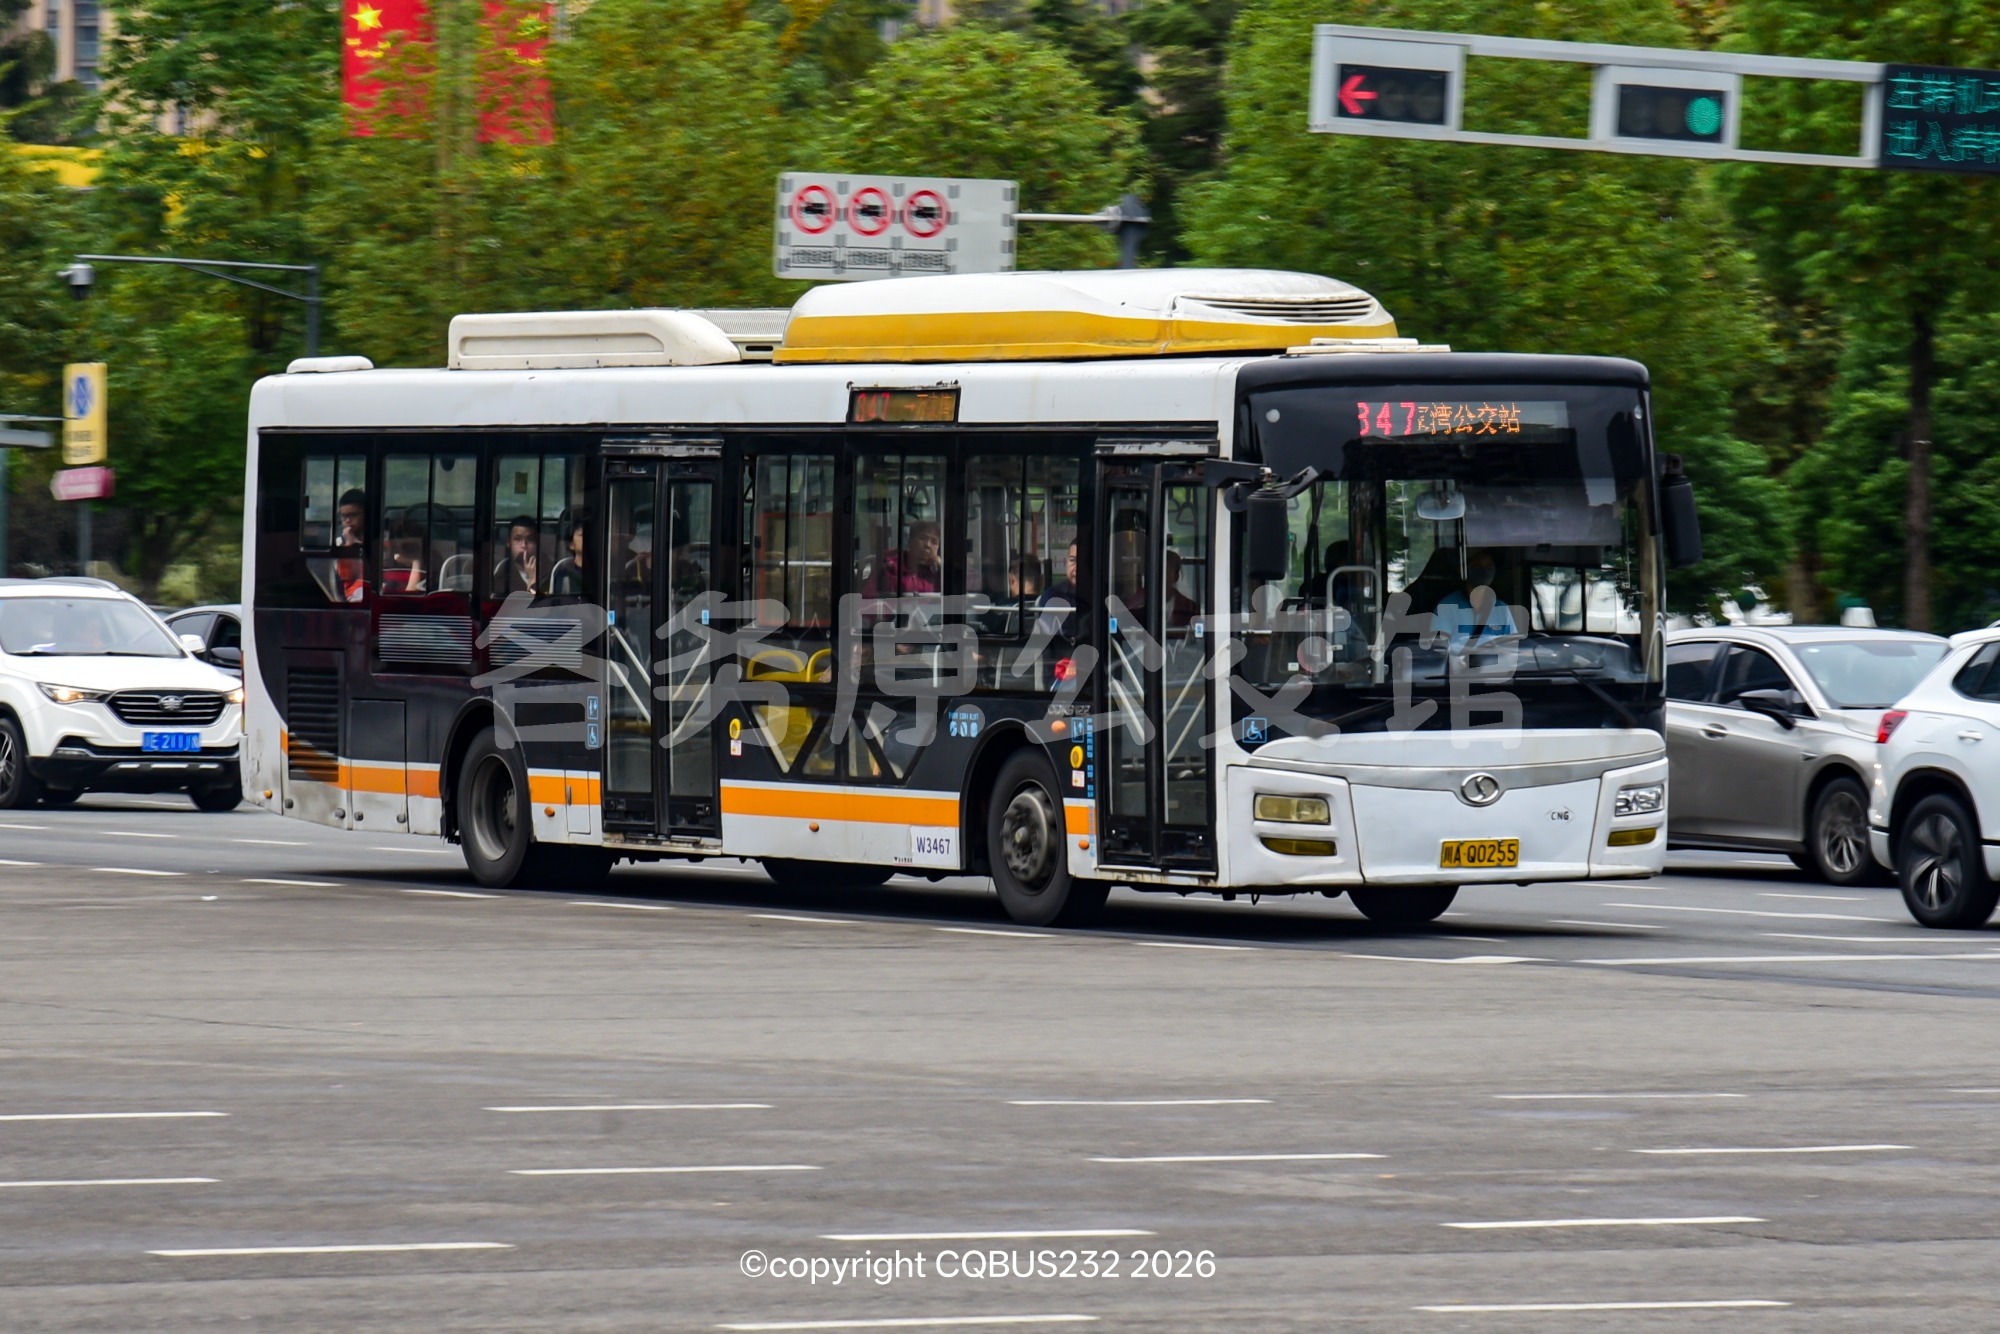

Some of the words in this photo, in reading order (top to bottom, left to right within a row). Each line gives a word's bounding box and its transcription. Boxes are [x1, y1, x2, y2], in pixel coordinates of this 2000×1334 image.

[1357, 402, 1416, 435] 347
[1550, 811, 1570, 821] CNG
[916, 836, 951, 855] W3467
